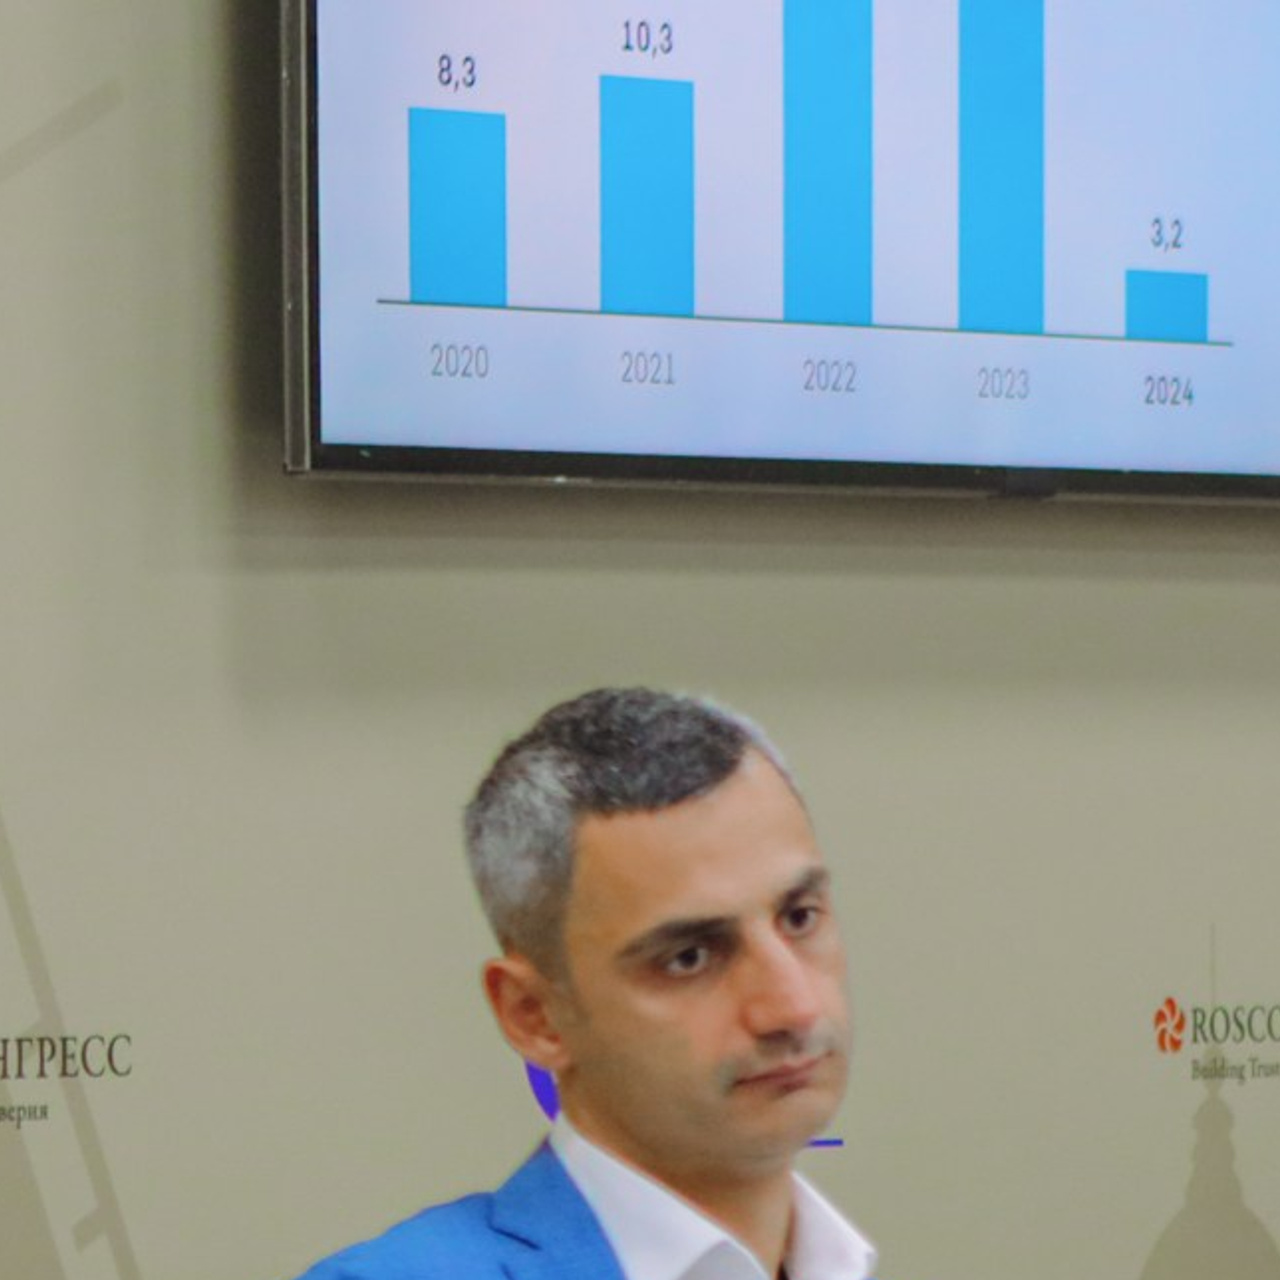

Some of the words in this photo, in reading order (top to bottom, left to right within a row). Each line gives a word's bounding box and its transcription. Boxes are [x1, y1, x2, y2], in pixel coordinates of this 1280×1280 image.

[621, 19, 674, 58] 10,3
[437, 54, 477, 91] 8,3
[1150, 217, 1183, 254] 3,2
[430, 343, 489, 379] 2020
[620, 351, 675, 386] 2021
[803, 359, 856, 394] 2022
[977, 365, 1030, 400] 2023
[1143, 375, 1194, 407] 2024
[1191, 1059, 1246, 1086] Building
